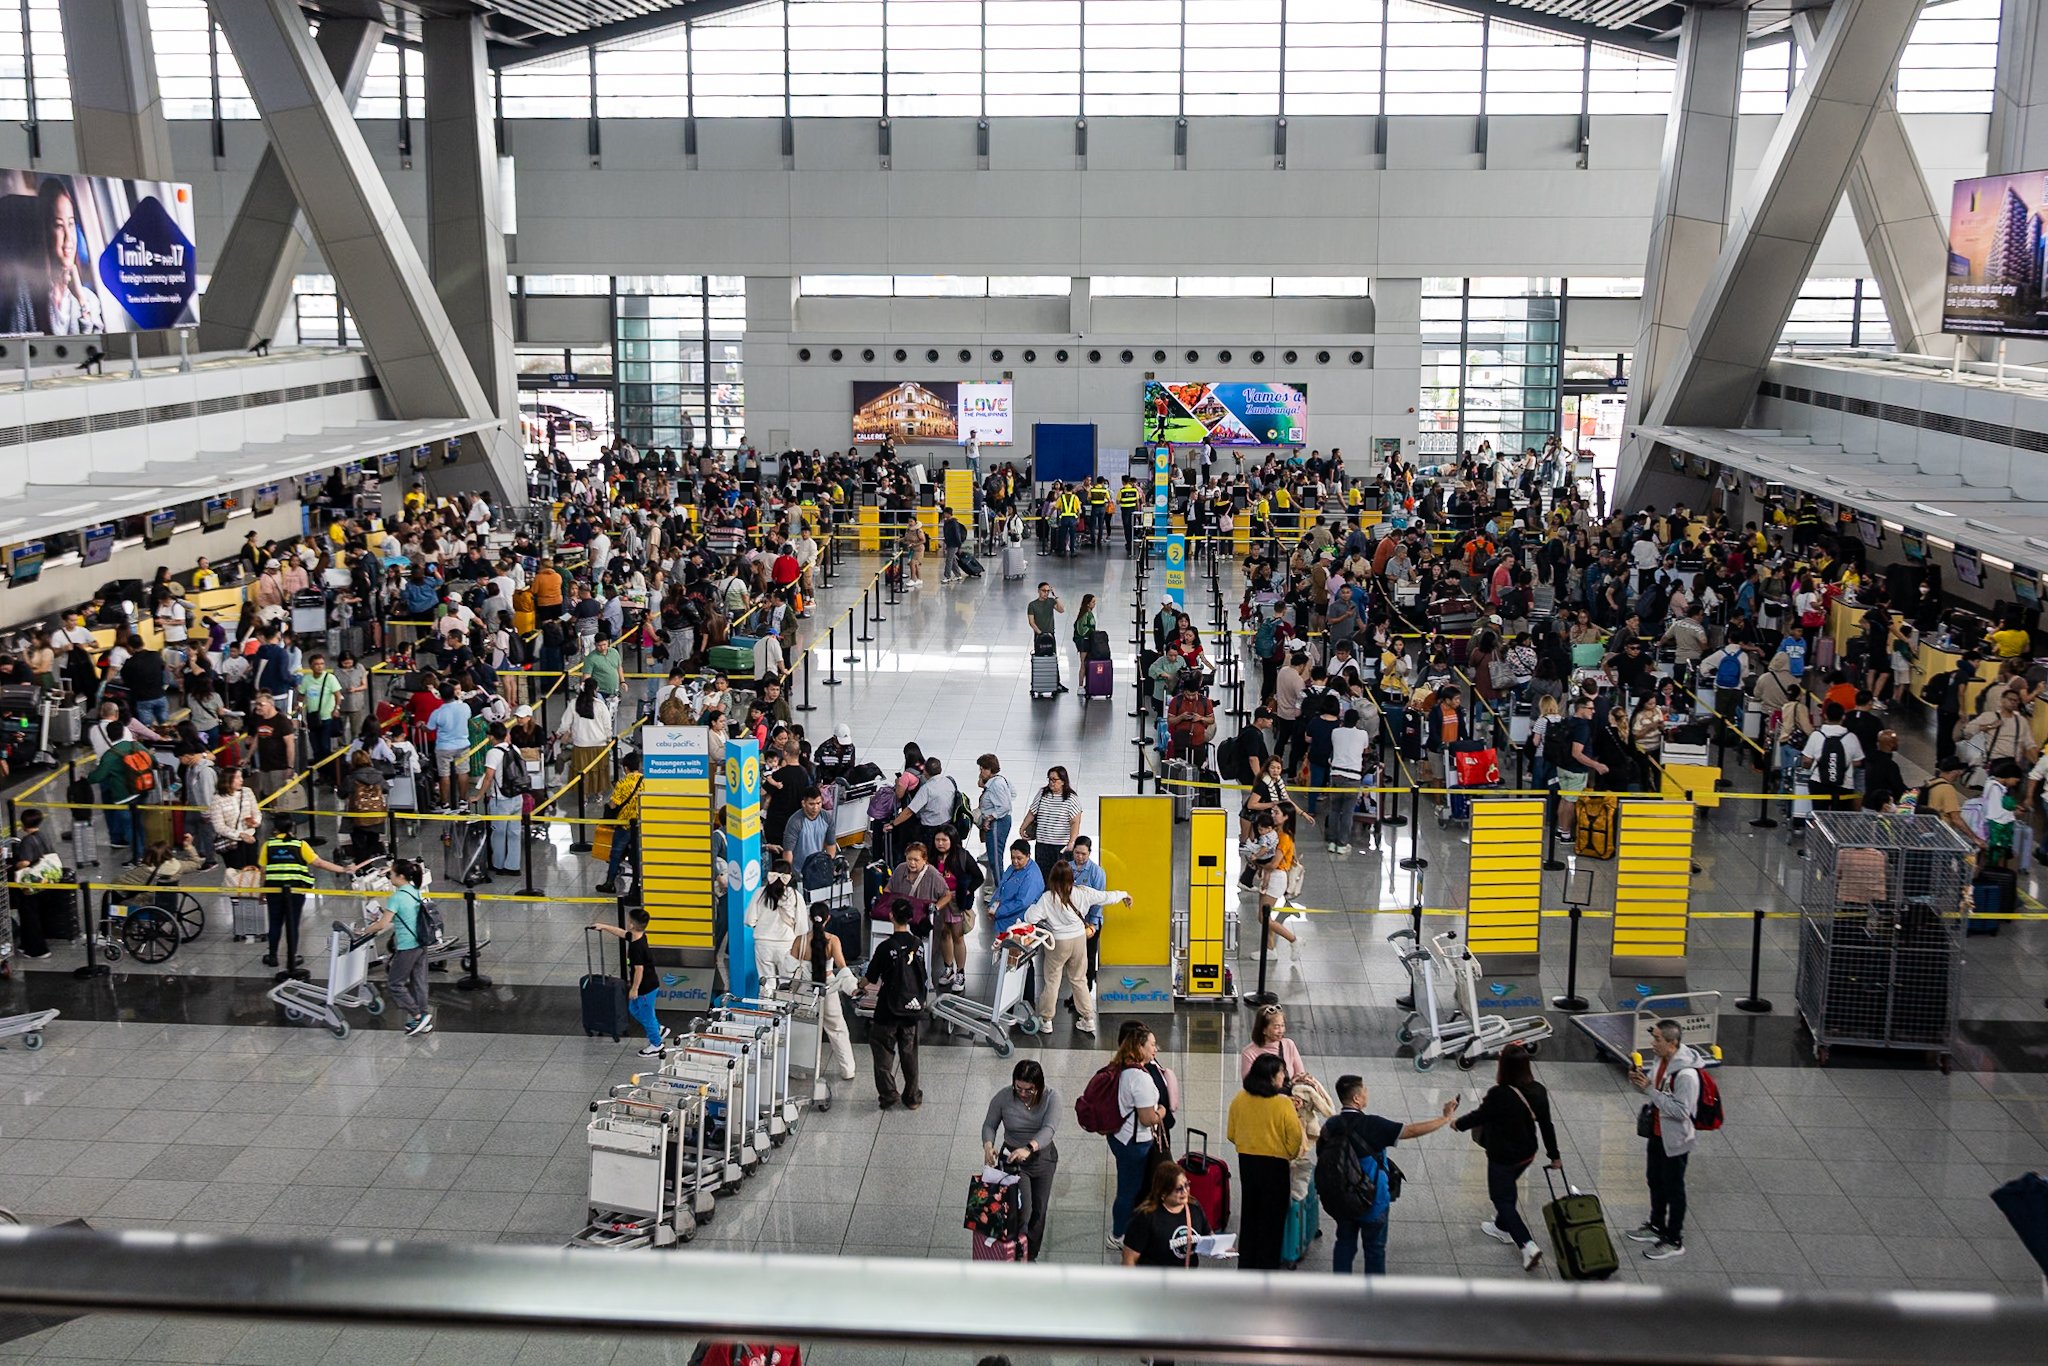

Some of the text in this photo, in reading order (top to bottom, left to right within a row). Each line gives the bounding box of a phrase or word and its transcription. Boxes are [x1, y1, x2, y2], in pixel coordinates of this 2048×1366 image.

[125, 240, 153, 266] mile
[1243, 388, 1303, 403] Vamos a
[964, 398, 1008, 412] LOVE
[1245, 404, 1300, 416] Zamboanga!
[1172, 550, 1179, 561] 2
[673, 740, 695, 748] pacific
[651, 760, 685, 768] Passengers
[1828, 752, 1837, 782] adidas
[677, 768, 703, 776] Mobility
[731, 770, 737, 787] 3
[748, 770, 754, 787] 3
[669, 988, 708, 1001] pacific
[1101, 990, 1169, 1003] cebu pacific
